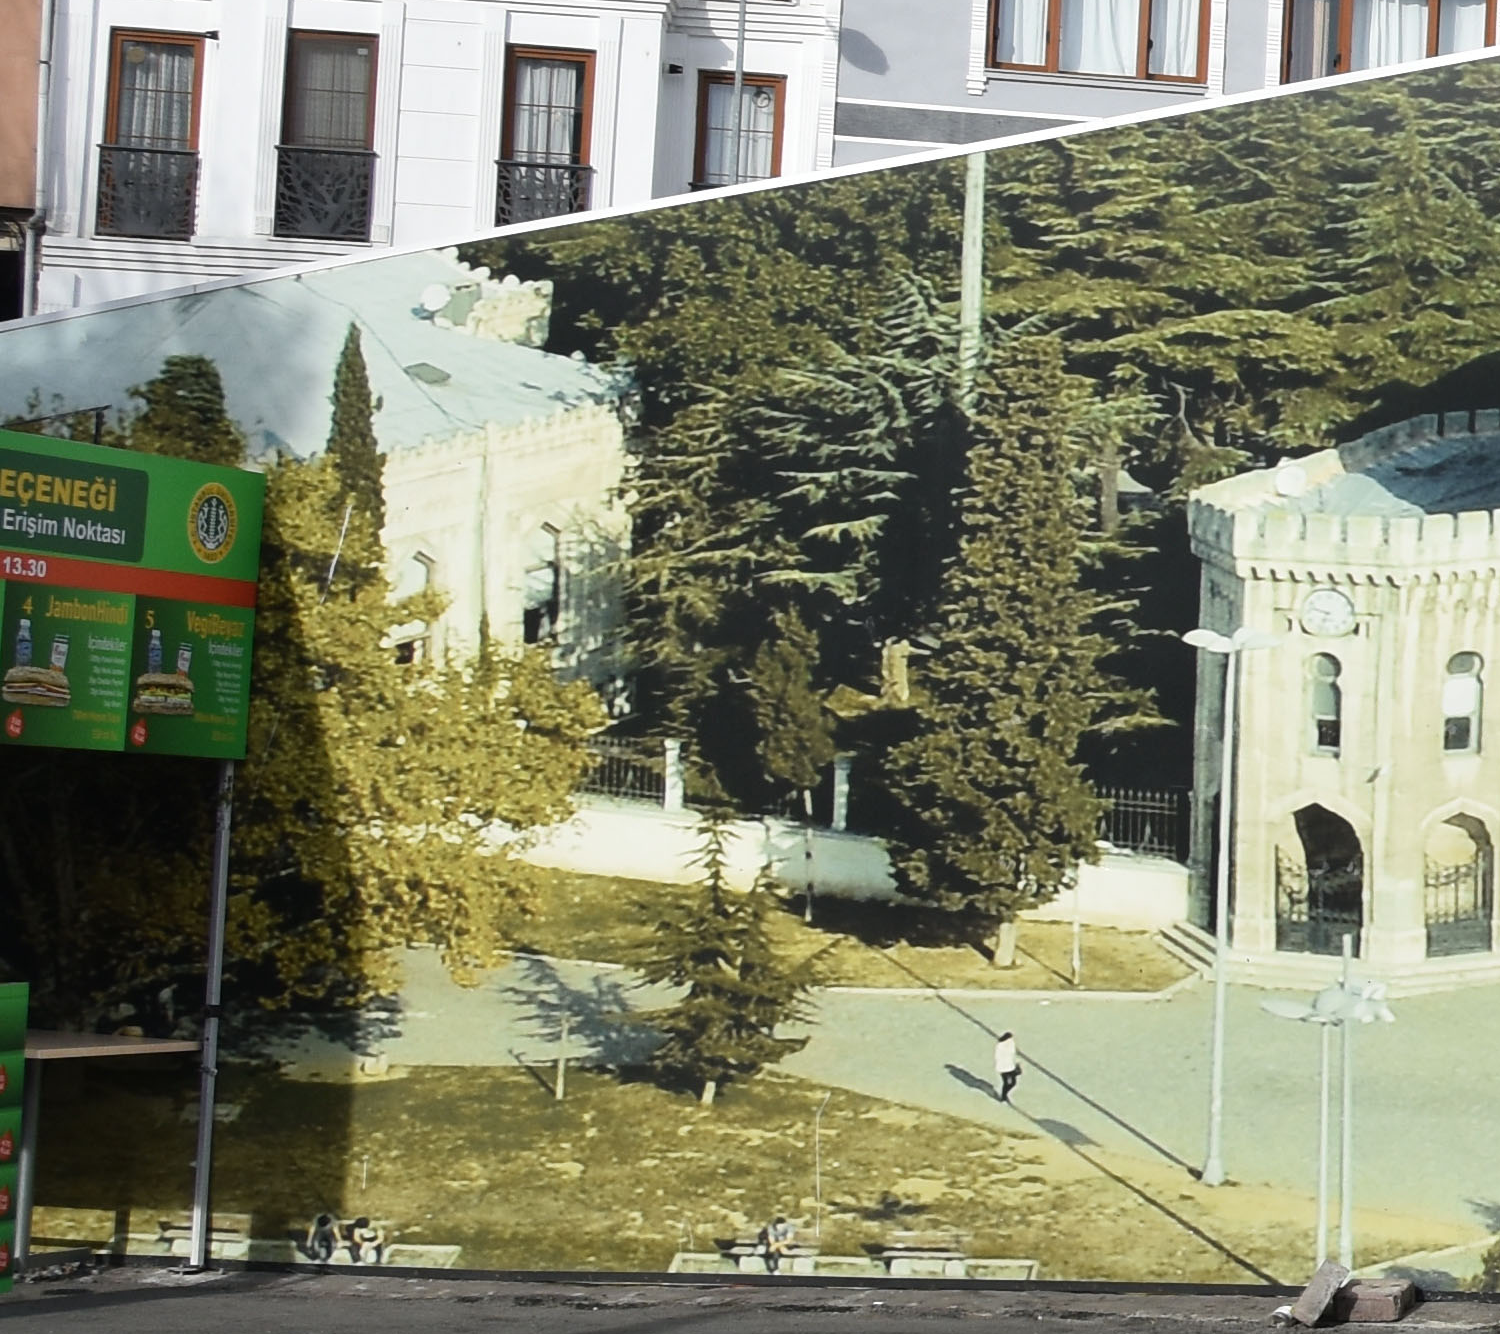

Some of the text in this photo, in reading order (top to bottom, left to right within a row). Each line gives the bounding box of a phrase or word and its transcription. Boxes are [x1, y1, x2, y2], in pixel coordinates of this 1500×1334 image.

[3, 508, 126, 545] Erişim Noktası
[3, 556, 47, 578] 13.30
[21, 595, 34, 616] 4
[144, 610, 156, 629] 5
